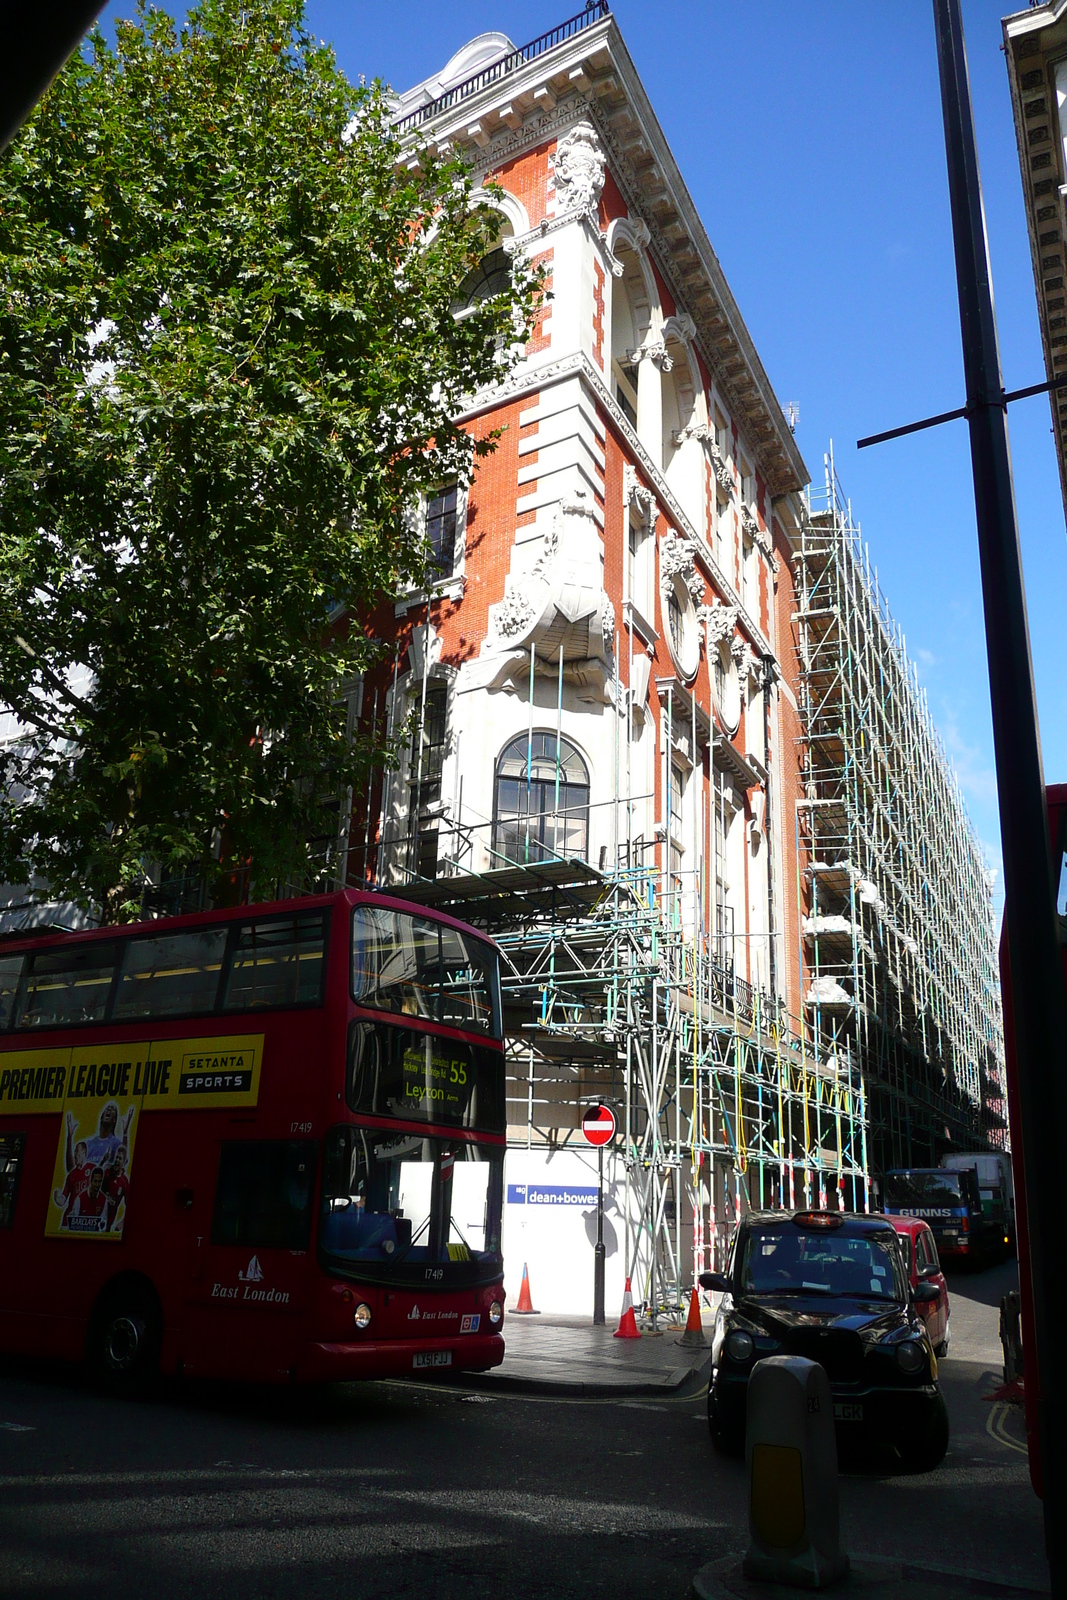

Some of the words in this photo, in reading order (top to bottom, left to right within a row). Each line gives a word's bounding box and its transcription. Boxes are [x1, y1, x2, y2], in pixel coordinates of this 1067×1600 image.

[189, 1056, 244, 1069] SETANTA
[449, 1059, 467, 1085] 55
[0, 1067, 66, 1100] PREMIER
[67, 1062, 131, 1098] LEAGUE
[133, 1060, 172, 1095] LIVE
[186, 1075, 243, 1089] SPORTS
[405, 1081, 445, 1102] Leyton
[290, 1121, 312, 1133] 17419
[529, 1191, 598, 1205] dean+bowes
[899, 1208, 952, 1217] GUNNS
[71, 1217, 99, 1226] BARCLAYS
[425, 1268, 444, 1280] 17419
[211, 1283, 238, 1298] East
[243, 1286, 290, 1303] London
[422, 1311, 436, 1319] East
[438, 1310, 458, 1319] London
[833, 1405, 861, 1418] LGK
